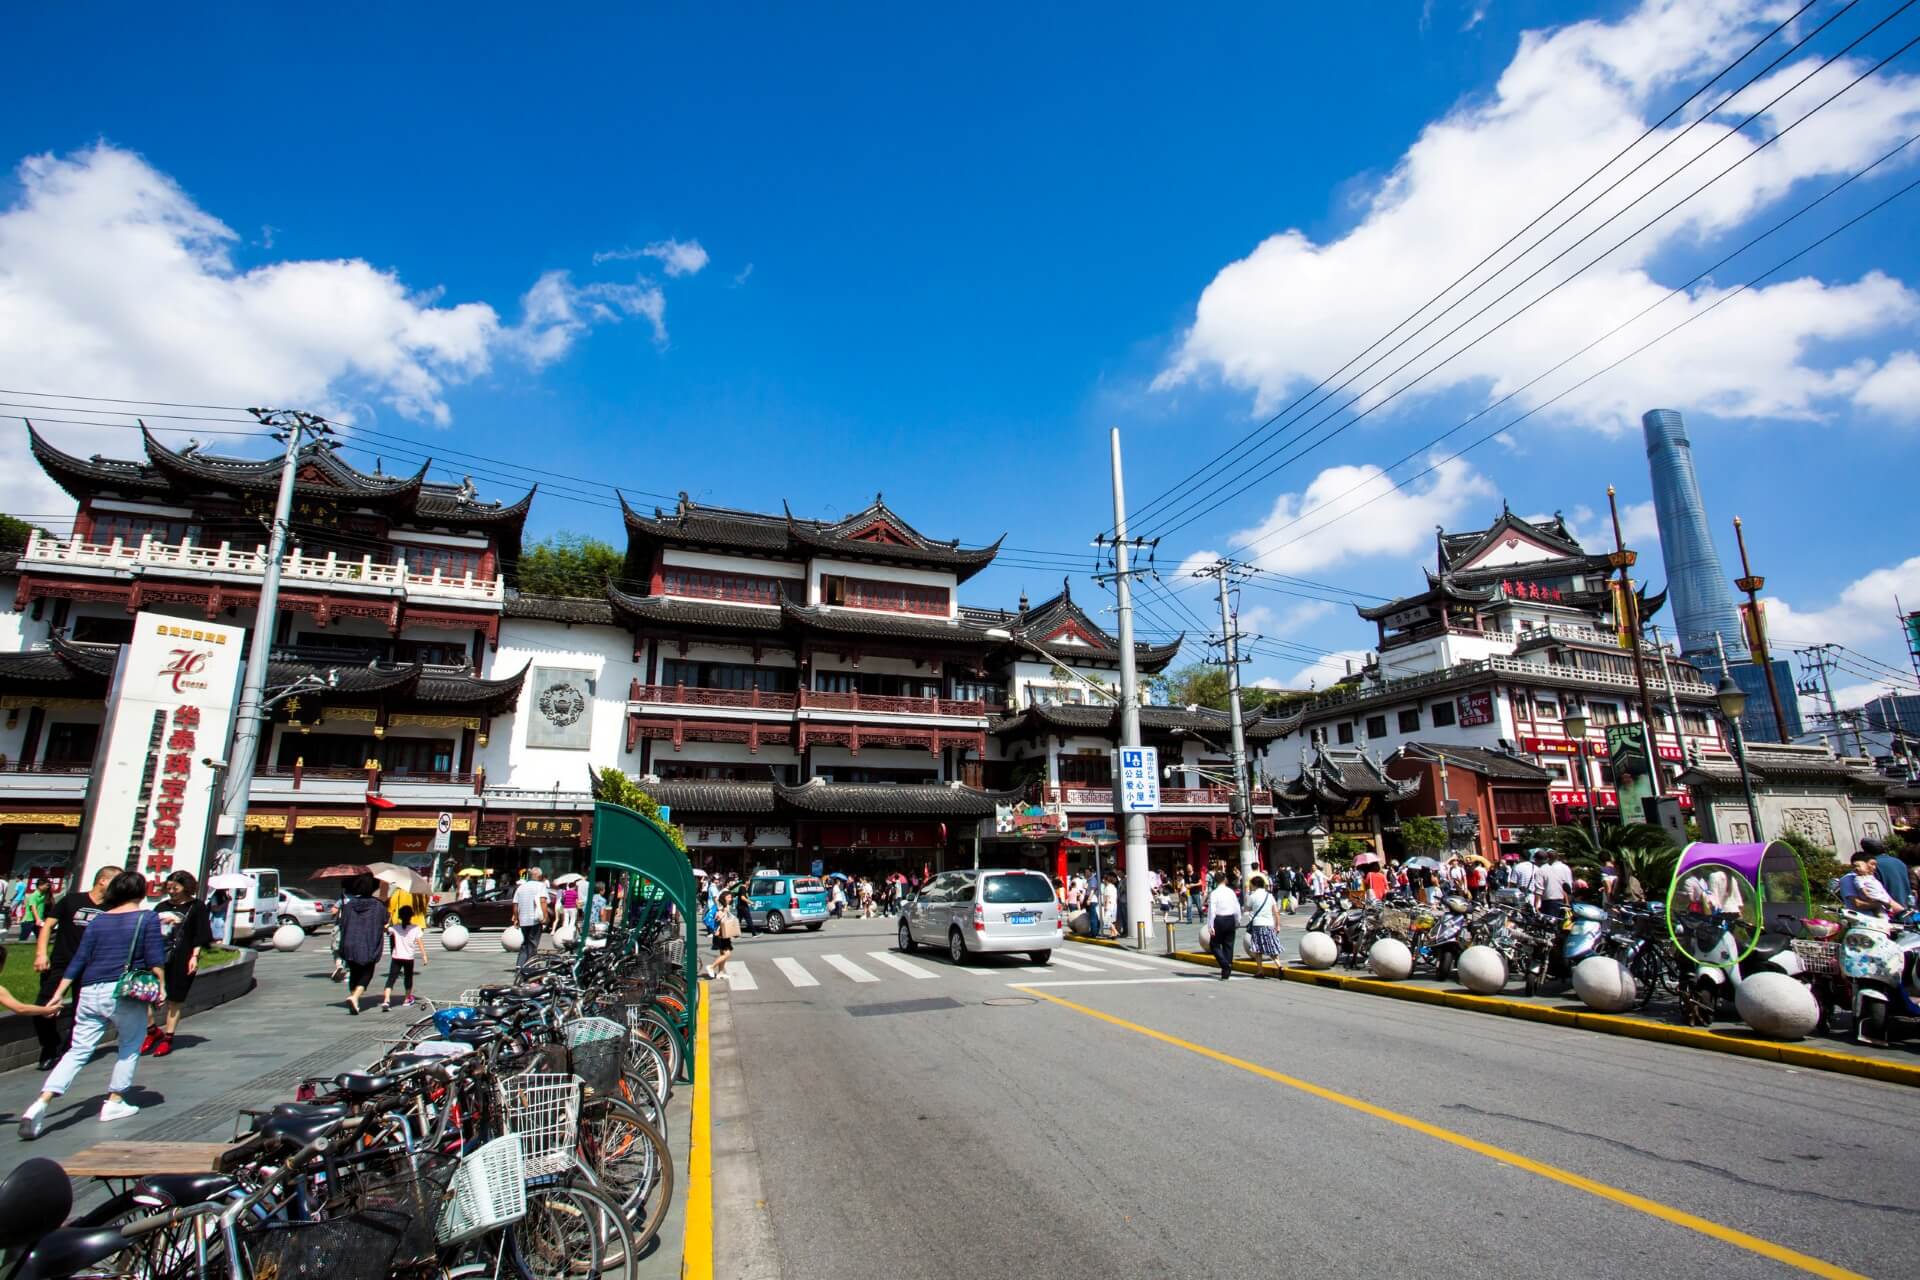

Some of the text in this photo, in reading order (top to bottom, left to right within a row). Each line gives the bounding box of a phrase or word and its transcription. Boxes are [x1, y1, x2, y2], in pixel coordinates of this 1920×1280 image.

[1472, 697, 1489, 707] KFC
[1125, 769, 1144, 779] 公益
[1126, 780, 1145, 790] 爱心
[389, 1145, 401, 1153] CITY
